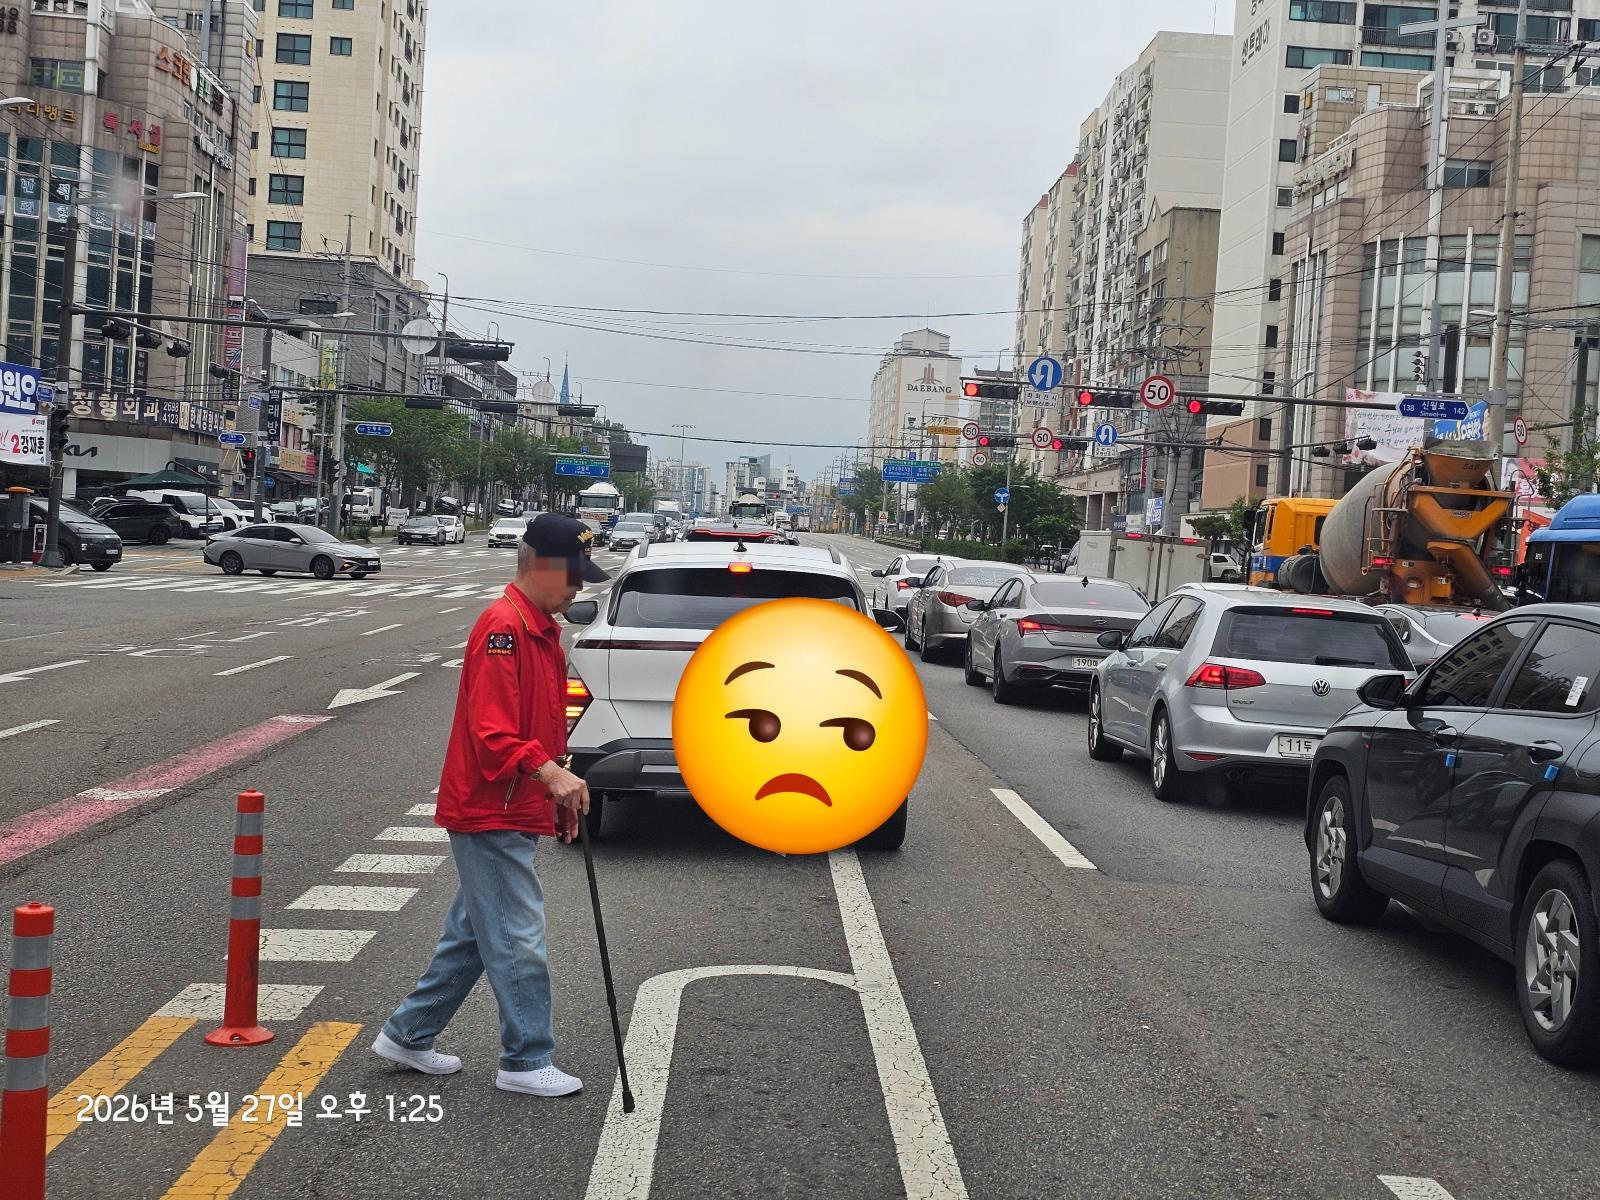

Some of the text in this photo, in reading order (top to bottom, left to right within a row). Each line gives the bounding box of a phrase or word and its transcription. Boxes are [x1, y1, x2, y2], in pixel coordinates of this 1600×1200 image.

[907, 383, 952, 394] DAEBANG
[1146, 384, 1169, 400] 50
[70, 389, 160, 422] 정형외과
[1403, 404, 1415, 412] 138
[1421, 402, 1446, 411] 신월로
[1453, 407, 1465, 415] 142
[162, 414, 179, 424] 4123
[965, 427, 977, 436] 50
[1036, 433, 1048, 443] 50
[11, 434, 21, 454] 2
[20, 435, 45, 455] 강재훈
